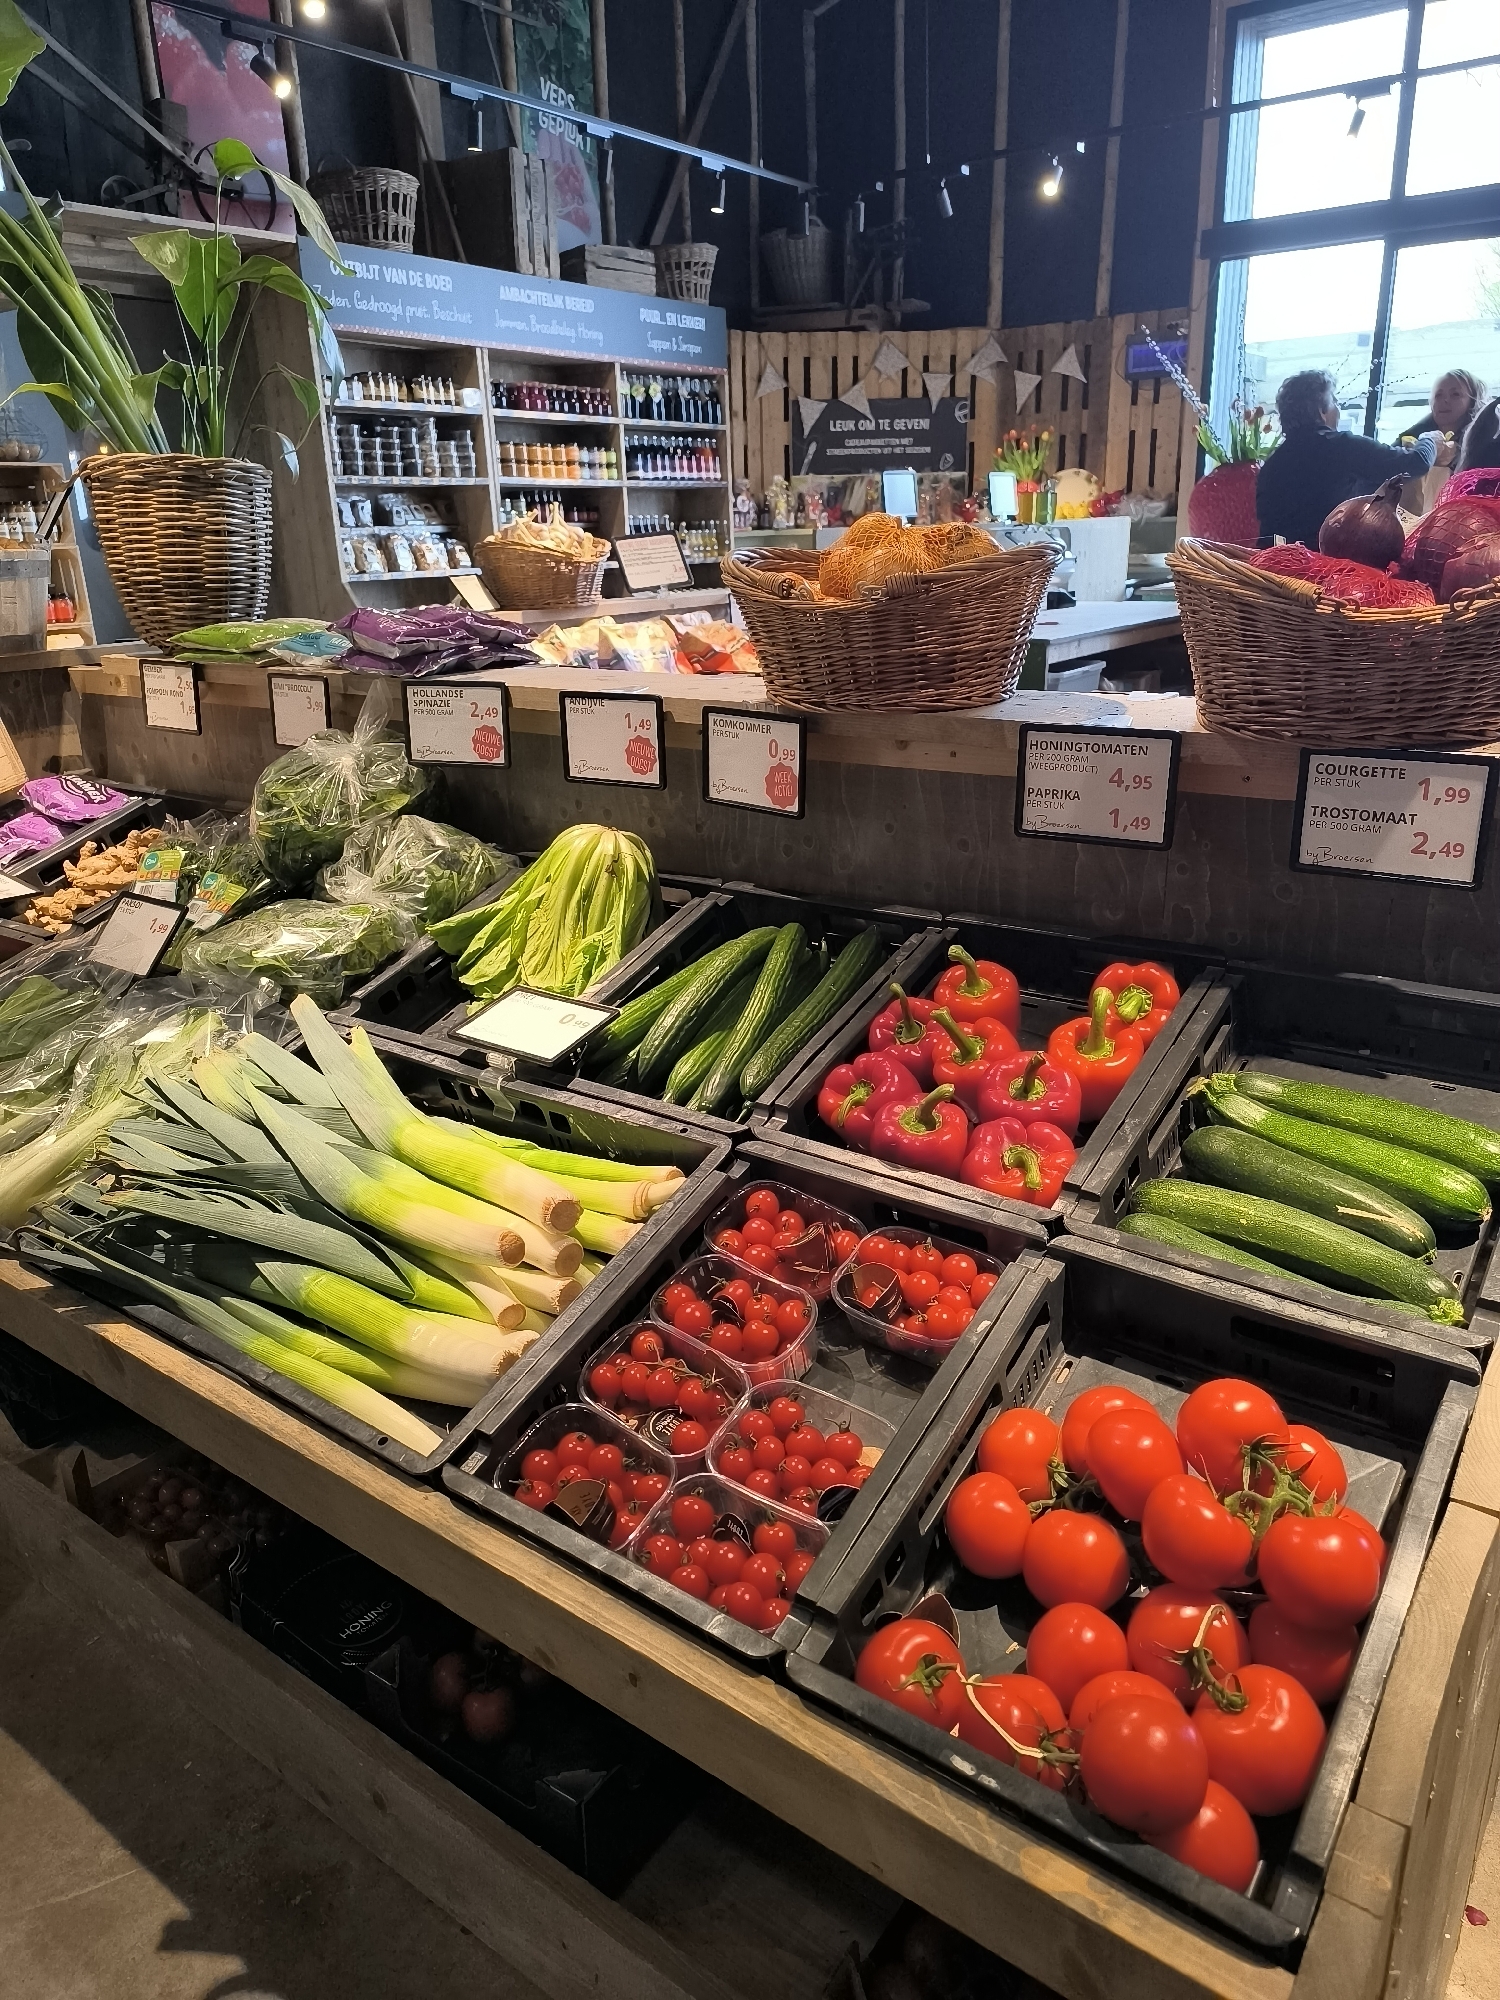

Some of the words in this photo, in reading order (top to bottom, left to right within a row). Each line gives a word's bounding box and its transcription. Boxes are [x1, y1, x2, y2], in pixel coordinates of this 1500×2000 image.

[539, 76, 576, 112] VERS
[382, 265, 408, 286] VAN
[408, 270, 425, 288] DE
[424, 273, 453, 293] BOER
[829, 420, 856, 432] LEUK
[857, 419, 876, 431] OM
[878, 418, 891, 431] TE
[412, 688, 464, 699] HOLLANDSE
[305, 696, 323, 713] 3,99
[413, 699, 451, 708] SPINAZIE
[469, 701, 499, 720] 2,49
[569, 697, 606, 709] ANDIJVIE
[569, 706, 580, 714] PER
[624, 712, 652, 733] 1,49
[712, 717, 772, 734] KOMKOMMER
[474, 729, 502, 747] NIEUWE
[712, 728, 725, 738] PER
[724, 730, 740, 740] STUK
[475, 743, 498, 758] OOGST
[629, 740, 657, 760] NIEUWE
[768, 738, 796, 762] 0,99
[1029, 739, 1149, 756] HONINGTOMATEN
[630, 755, 653, 773] OOGST
[1028, 752, 1045, 761] PER
[1046, 753, 1062, 762] 200
[1063, 754, 1090, 764] GRAM
[1028, 761, 1099, 774] (WEEGPRODUCT)
[1315, 762, 1407, 780] COURGETTE
[773, 771, 793, 784] WEEK
[1108, 767, 1154, 793] 4,95
[1313, 777, 1332, 787] PER
[1334, 778, 1362, 789] STUK
[1027, 787, 1081, 801] PAPRIKA
[1417, 777, 1471, 806] 1,99
[1026, 800, 1042, 808] PER
[1043, 800, 1066, 810] STUK
[1108, 808, 1151, 833] 1,49
[1310, 805, 1418, 826] TROSTOMAAT
[1309, 820, 1327, 829] PER
[1329, 821, 1349, 831] 500
[1350, 823, 1382, 834] GRAM
[1410, 831, 1465, 860] 2,49
[1305, 849, 1319, 865] by
[149, 917, 169, 934] 1,99
[558, 1013, 591, 1029] 0,99
[338, 1600, 393, 1639] HONING
